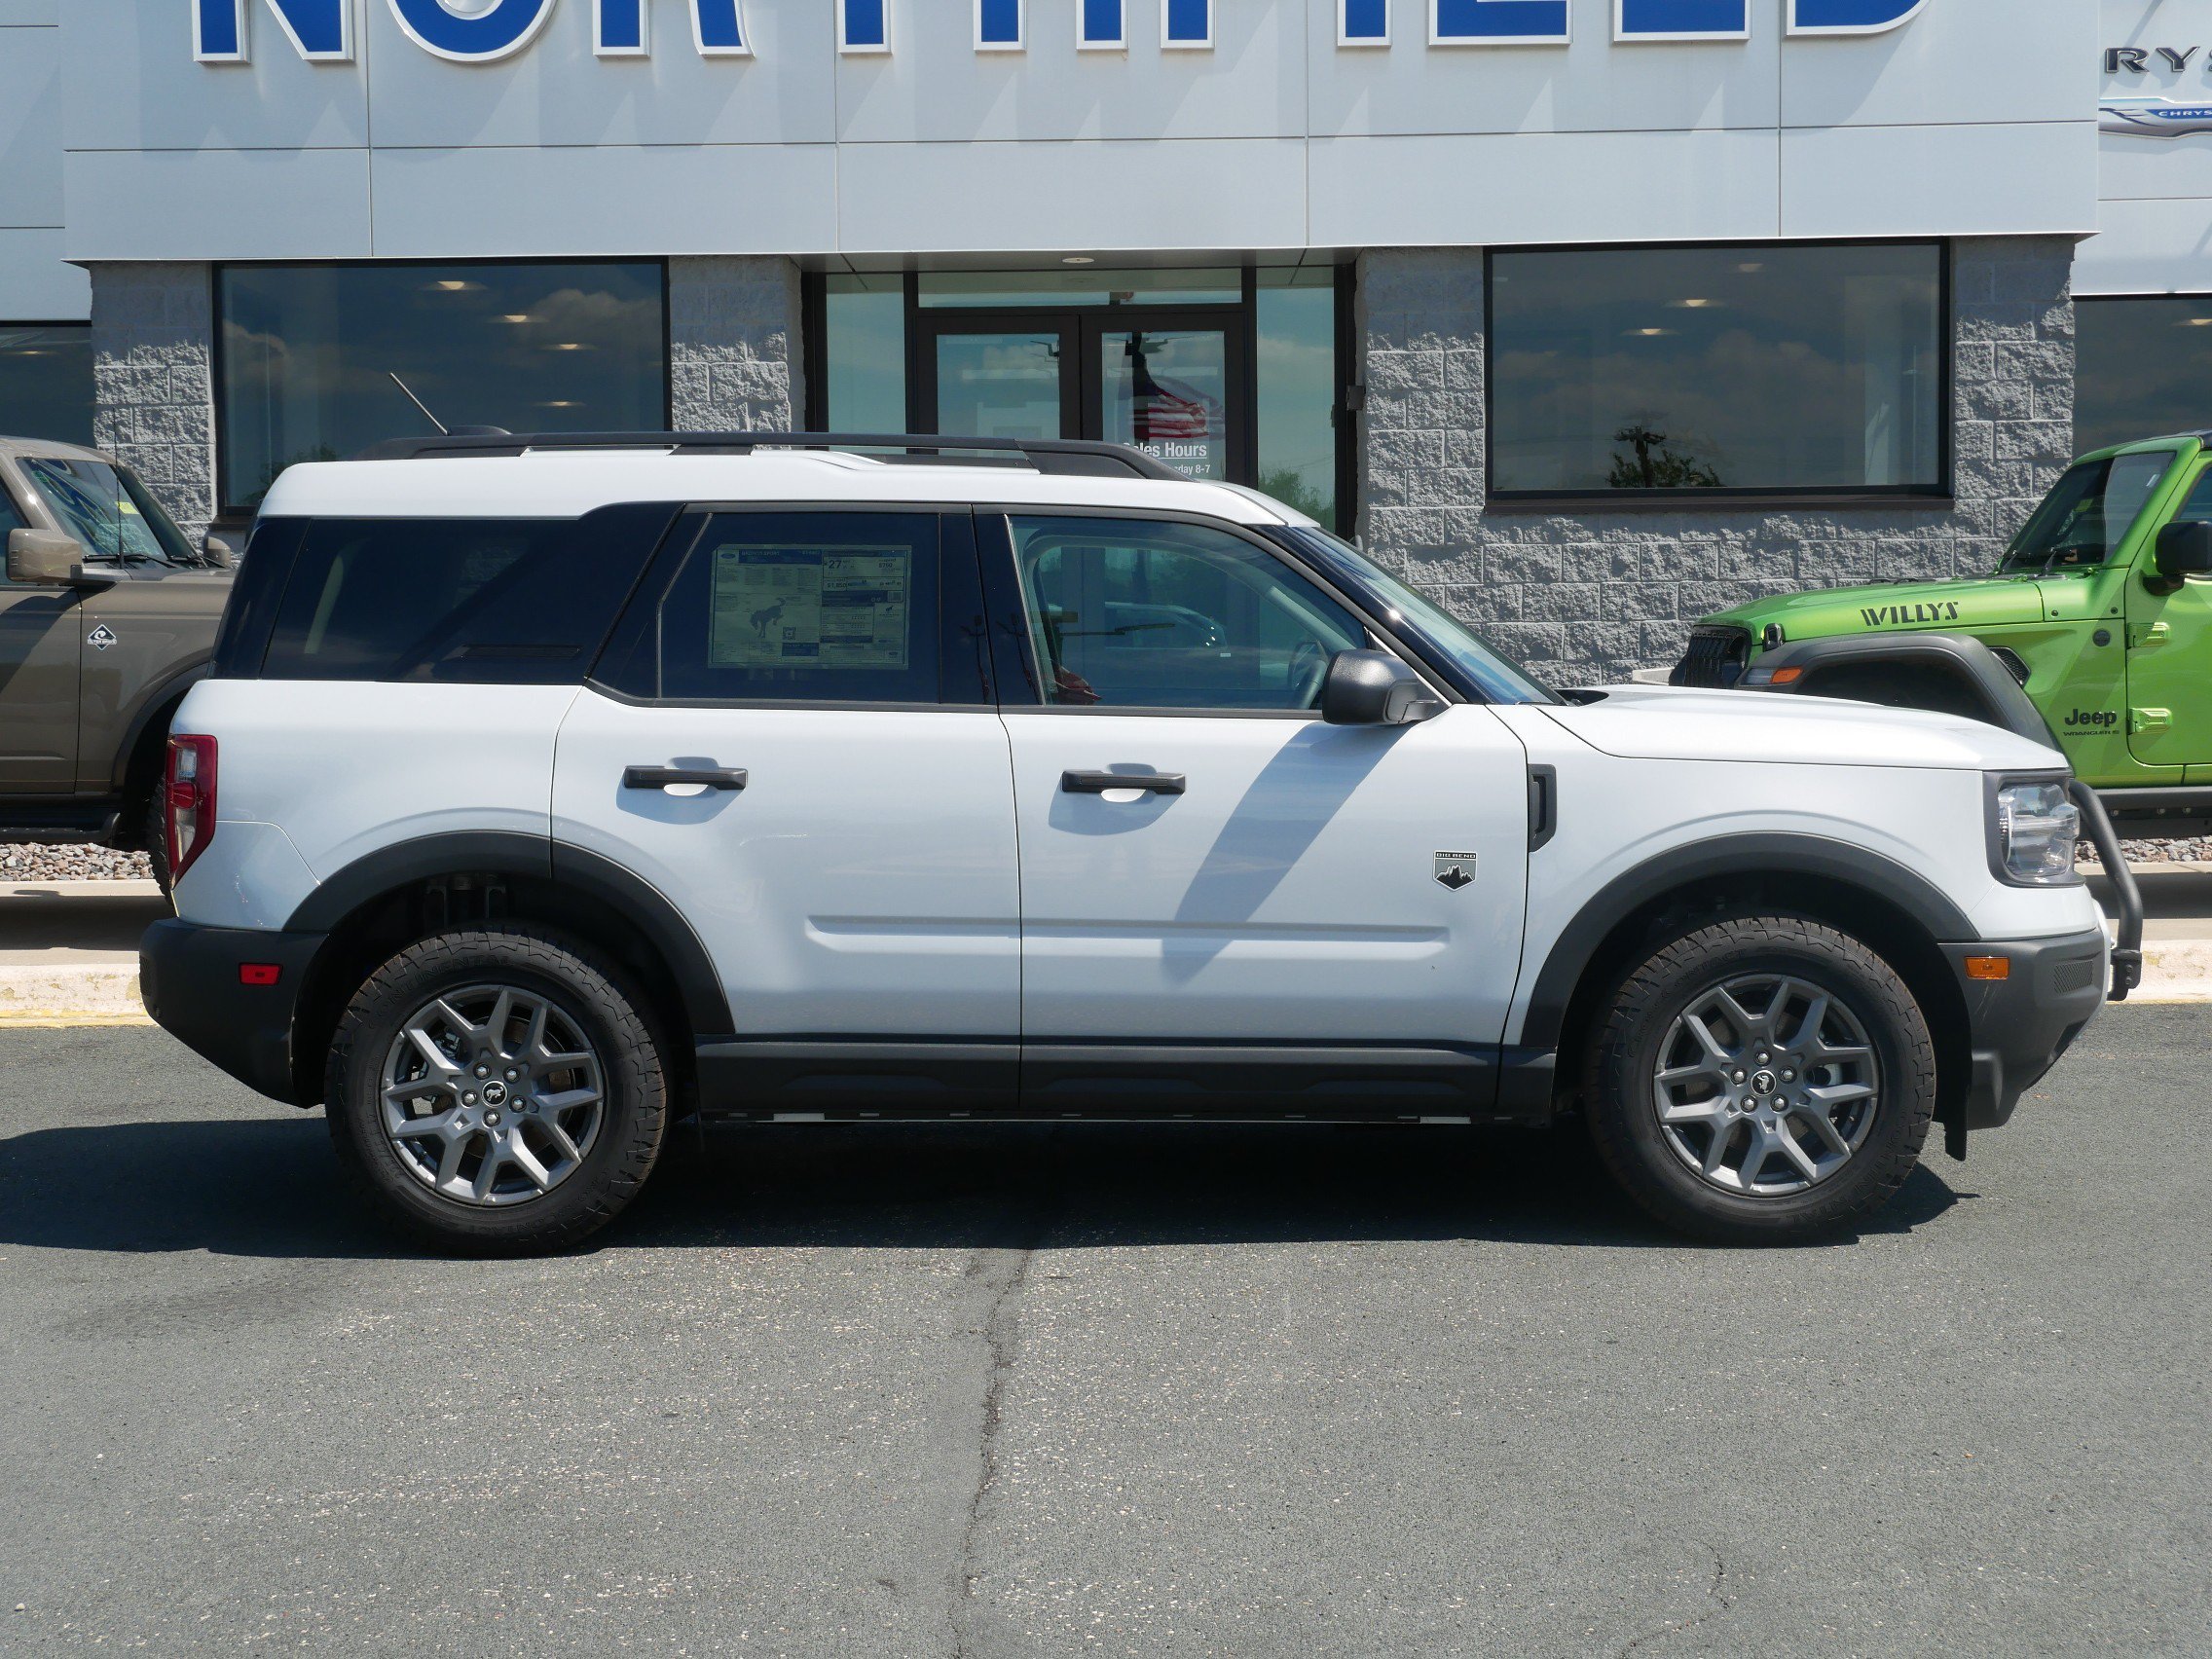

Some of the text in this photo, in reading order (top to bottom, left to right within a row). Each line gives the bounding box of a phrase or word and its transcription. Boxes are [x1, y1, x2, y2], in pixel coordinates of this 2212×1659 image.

[2105, 46, 2212, 73] RY
[1124, 442, 1207, 458] les Hours
[1195, 464, 1211, 474] 8-7
[829, 560, 842, 570] 27
[1861, 602, 1959, 626] WILLYS
[2064, 708, 2118, 727] Jeep
